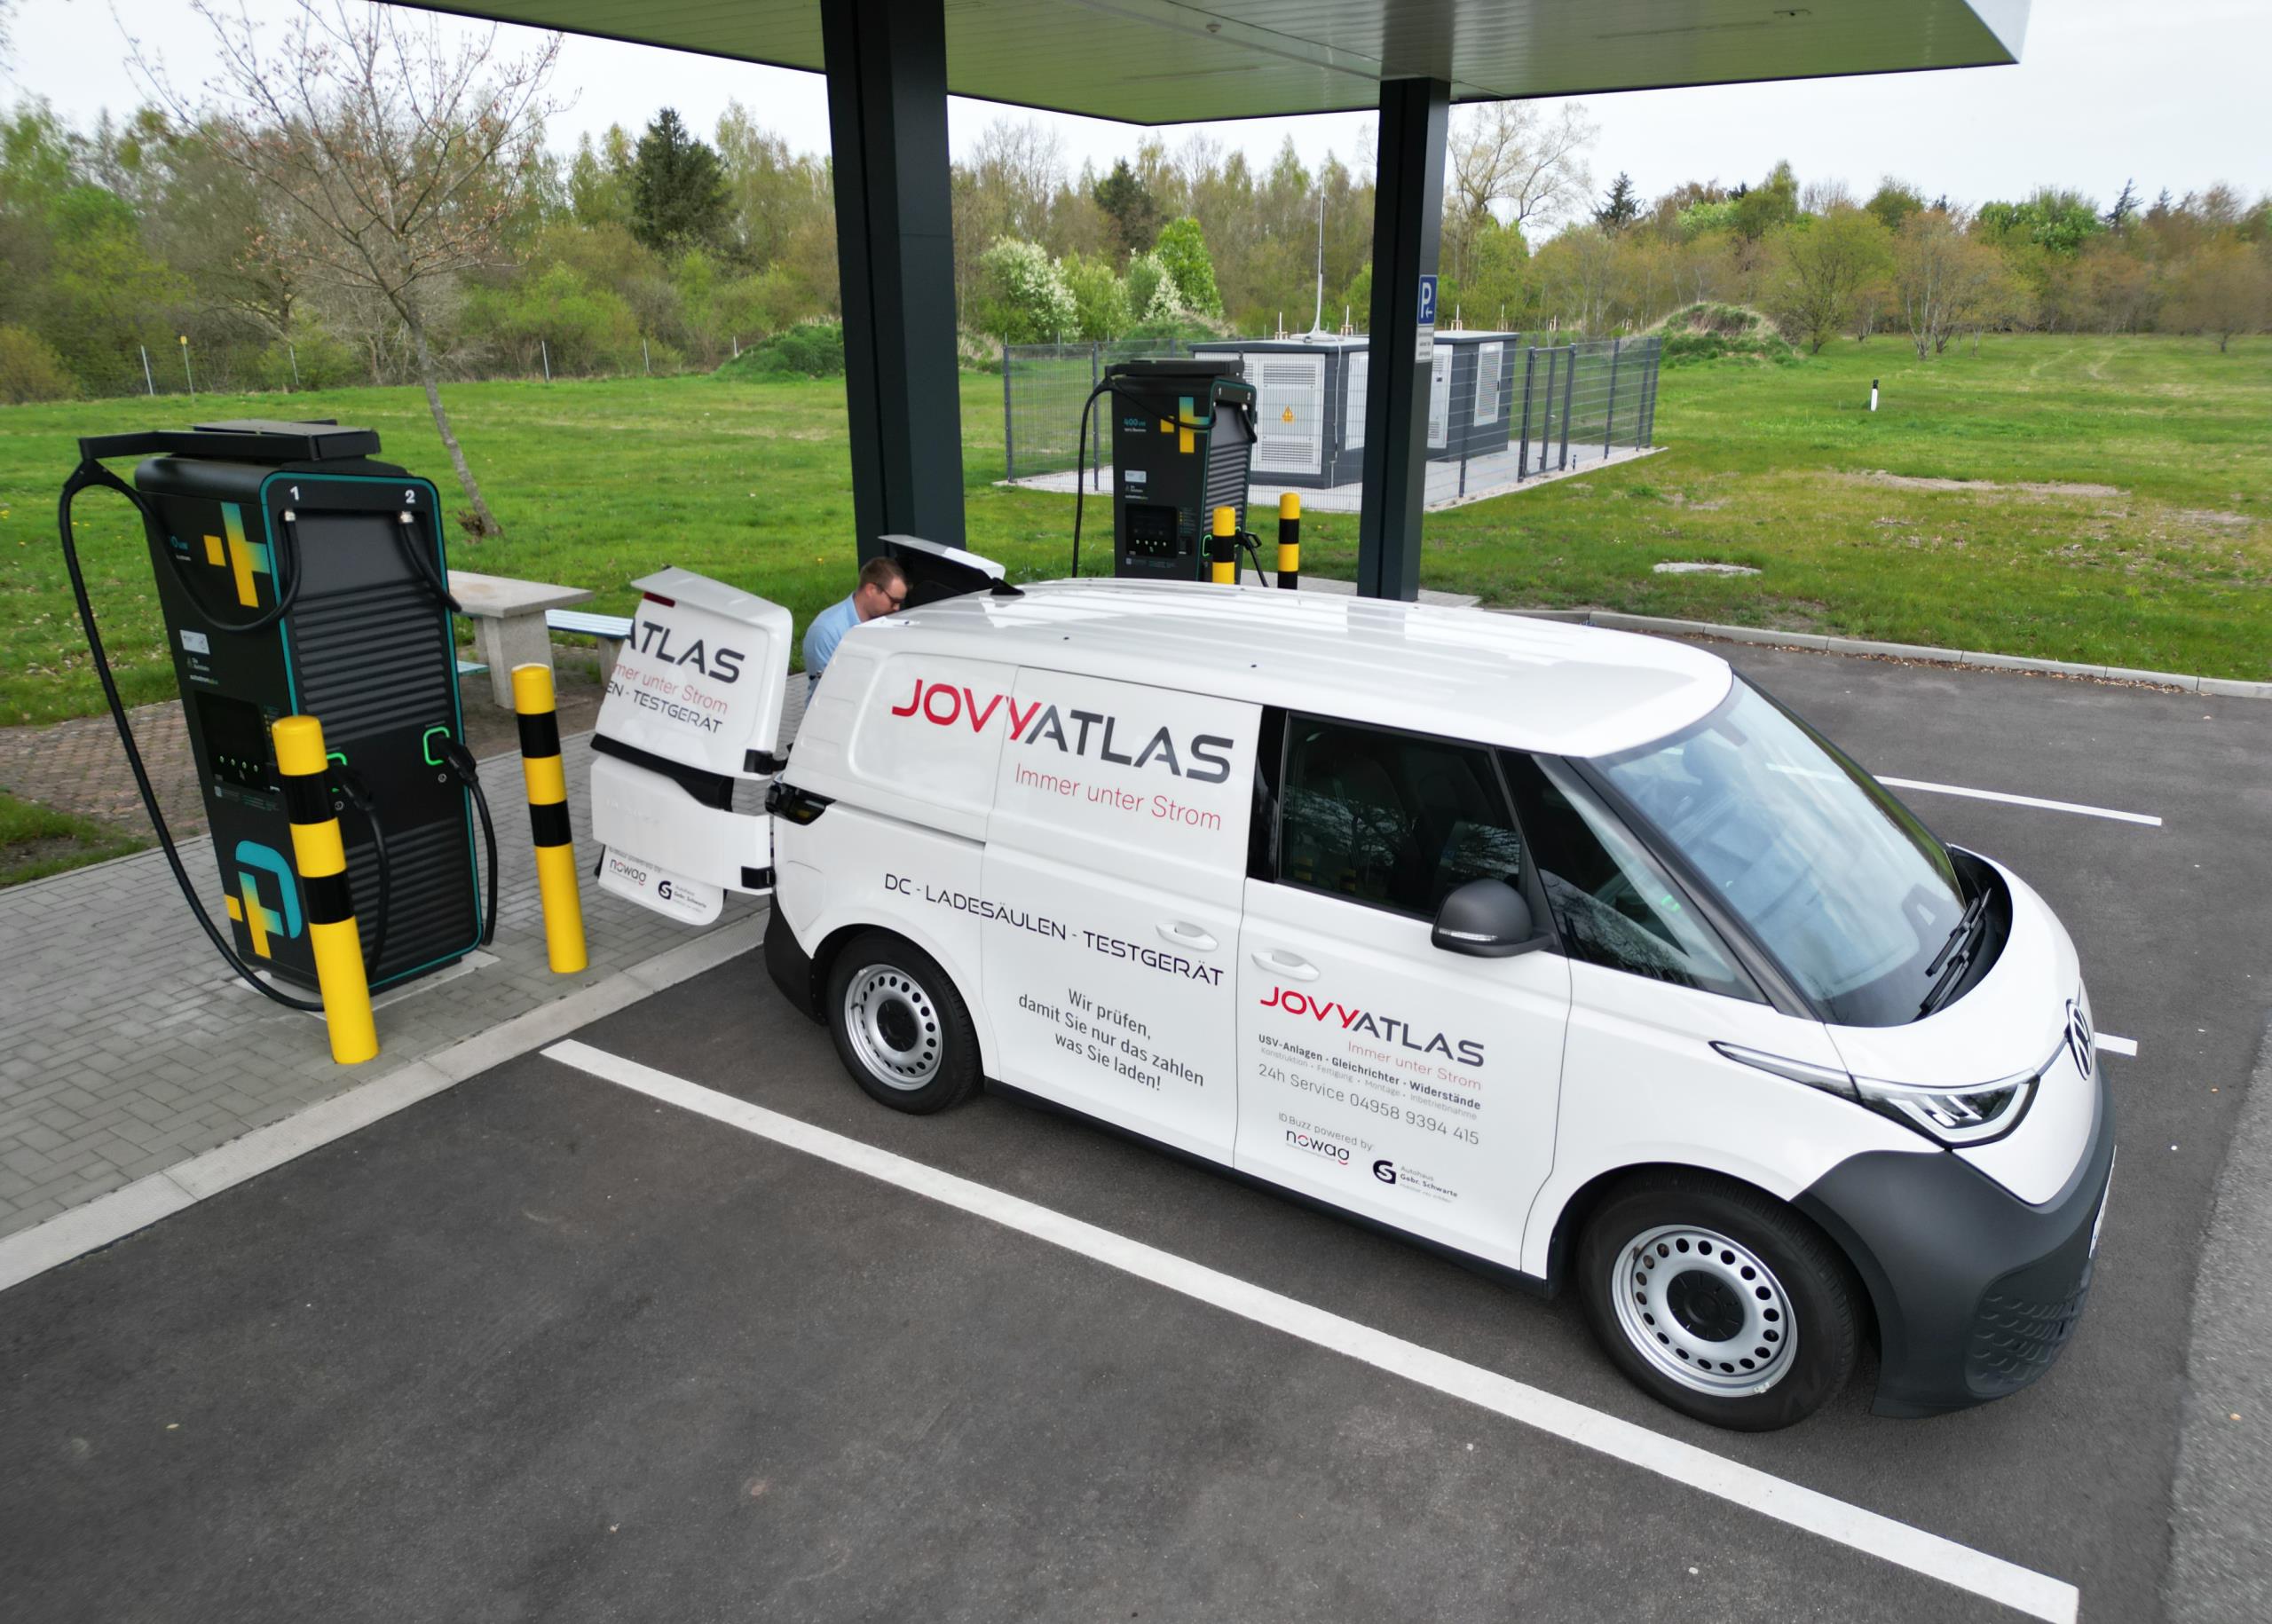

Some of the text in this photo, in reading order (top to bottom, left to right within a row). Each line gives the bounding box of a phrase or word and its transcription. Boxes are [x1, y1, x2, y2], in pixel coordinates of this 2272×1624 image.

[1421, 282, 1432, 319] P
[290, 486, 415, 503] 1 2
[643, 674, 679, 695] unter
[682, 684, 728, 715] Strom
[891, 679, 1235, 784] JOVYATLAS
[1015, 763, 1221, 831] Immer unter Strom
[610, 859, 647, 887] nowag
[885, 873, 911, 895] DC
[926, 885, 1066, 940] LADESÄULEN
[1083, 930, 1224, 986] TESTGERÄT
[1019, 994, 1203, 1087] damit Sie nur das zahlen
[1069, 988, 1151, 1040] Wir prüfen,
[1260, 986, 1484, 1068] JOVYATLAS
[1055, 1033, 1161, 1091] was Sie laden!
[1258, 1034, 1481, 1110] USV-Anlagen Gleichrichter Widerstände
[1348, 1041, 1481, 1091] Immer unter Strom
[1258, 1063, 1479, 1145] 24h Service 04958 9394 415
[1287, 1130, 1350, 1165] nowag
[1314, 1126, 1357, 1146] powered
